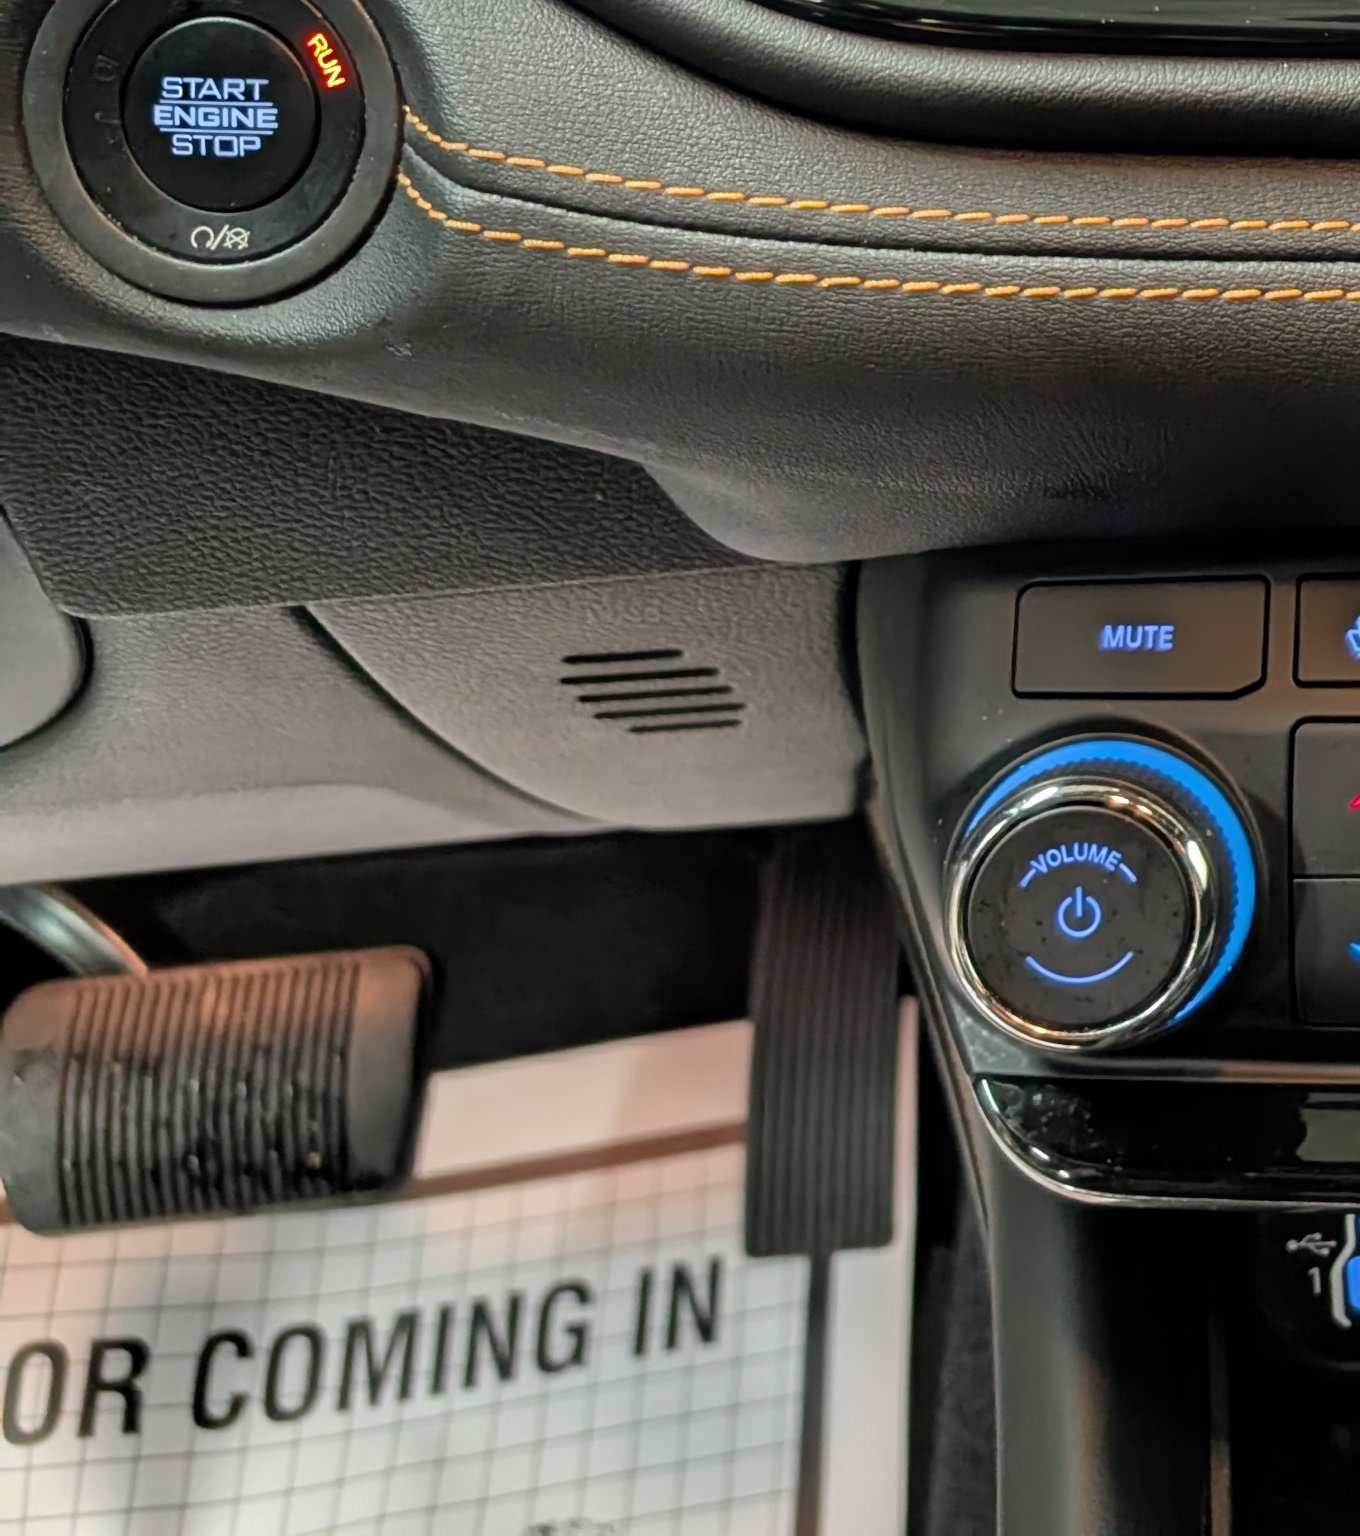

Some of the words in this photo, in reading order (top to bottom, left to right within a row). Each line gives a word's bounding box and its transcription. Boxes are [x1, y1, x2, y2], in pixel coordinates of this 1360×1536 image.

[307, 33, 346, 88] RUN
[161, 77, 270, 101] START
[152, 104, 279, 129] ENGINE
[171, 135, 262, 158] STOP
[1100, 624, 1174, 651] MUTE
[1030, 842, 1122, 874] VOLUME
[1307, 1266, 1323, 1295] 1
[3, 1338, 151, 1446] OR
[191, 1278, 600, 1432] COMING
[631, 1252, 724, 1360] IN
